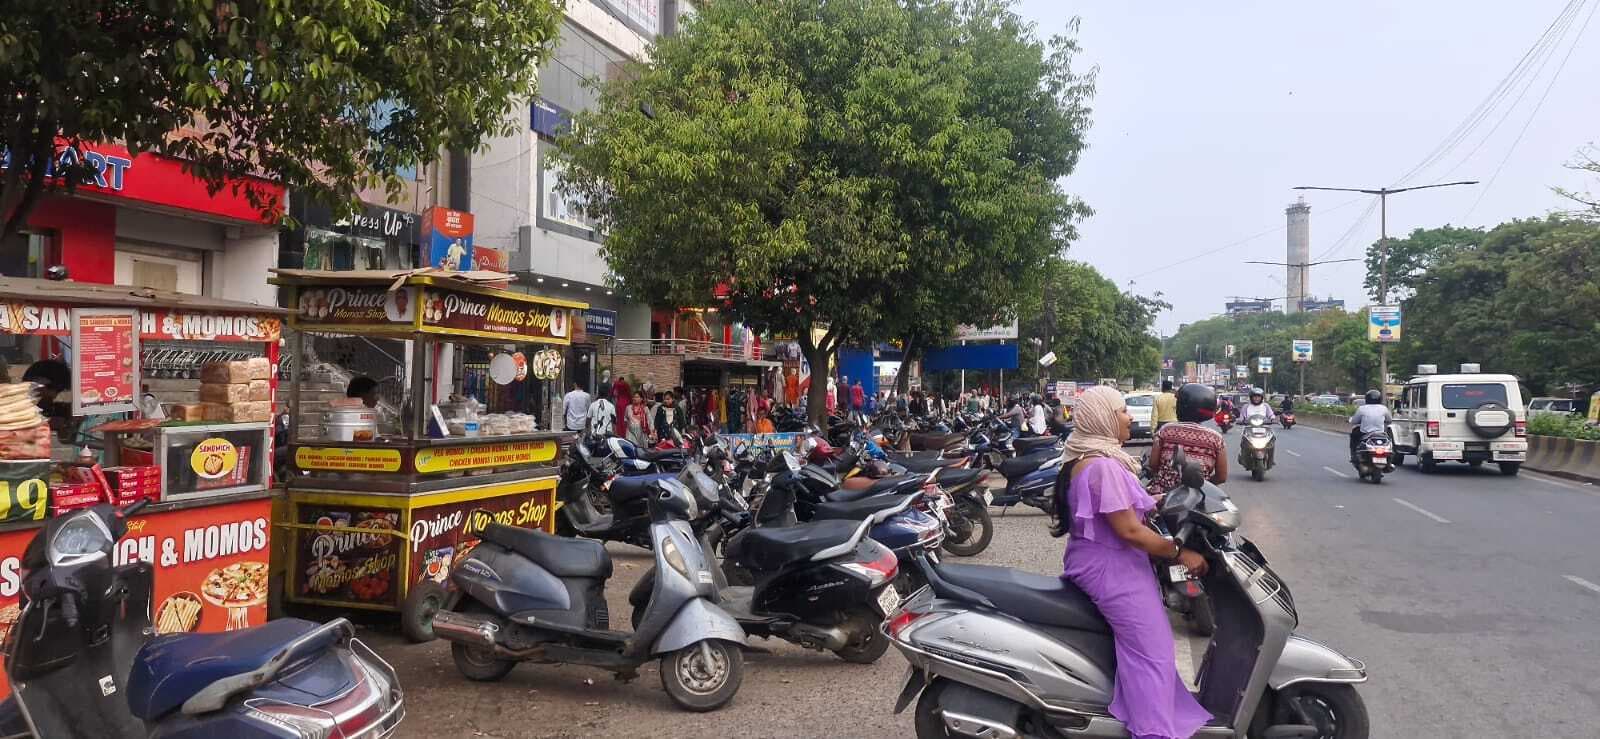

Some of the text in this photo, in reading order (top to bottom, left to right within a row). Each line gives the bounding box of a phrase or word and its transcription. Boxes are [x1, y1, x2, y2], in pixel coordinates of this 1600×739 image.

[44, 145, 131, 190] ART
[384, 211, 403, 236] Up
[327, 288, 385, 313] Prince
[444, 294, 486, 319] Prince
[487, 303, 524, 324] Momos
[526, 309, 550, 329] Shop
[182, 315, 258, 337] MOMOS
[160, 537, 178, 567] &
[183, 518, 267, 563] MOMOS
[410, 510, 463, 553] Prince
[516, 497, 548, 526] Shop
